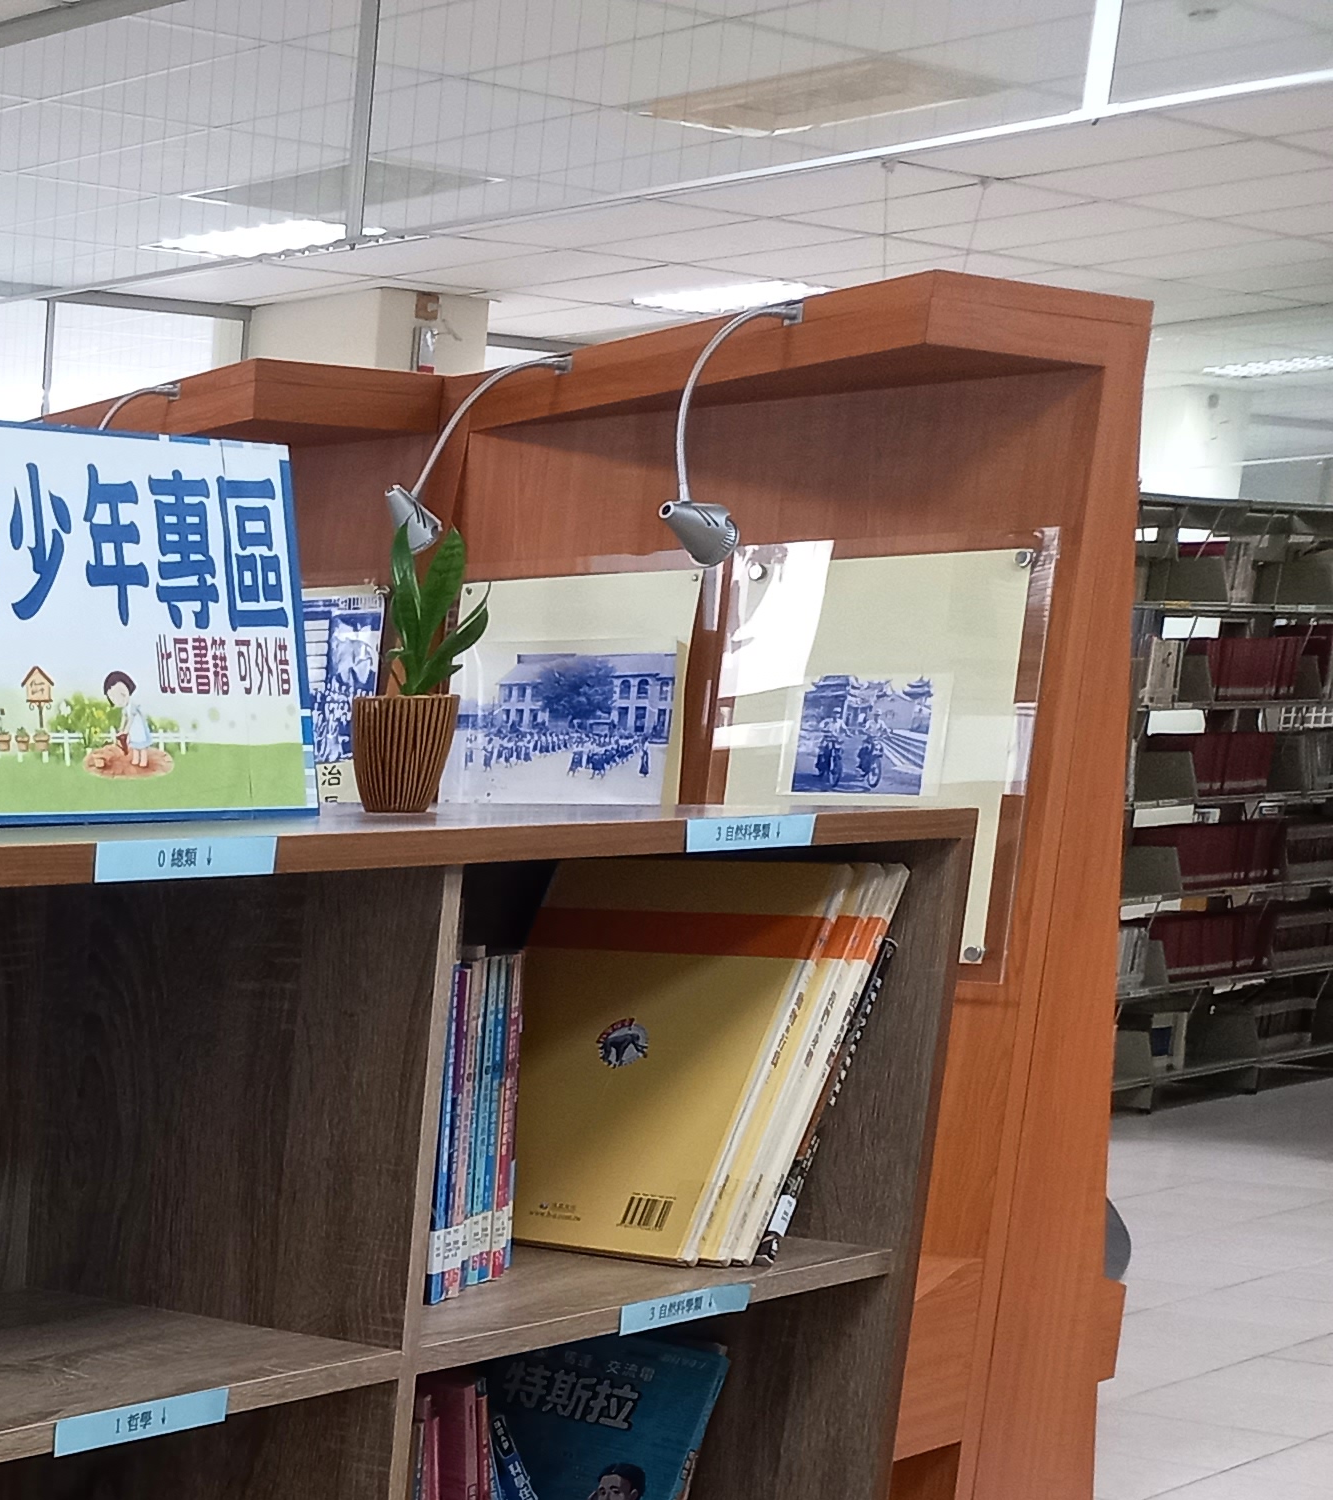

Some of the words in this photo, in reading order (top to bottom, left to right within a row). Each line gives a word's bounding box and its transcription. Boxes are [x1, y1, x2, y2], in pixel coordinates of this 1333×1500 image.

[156, 634, 230, 696] 此區書籍
[234, 638, 290, 697] 可外借
[715, 823, 723, 842] 3
[724, 821, 771, 842] 自然科學類
[157, 850, 165, 868] 0
[171, 846, 198, 869] 總類
[648, 1307, 655, 1321] 3
[658, 1296, 703, 1319] 自然科學類
[503, 1361, 641, 1431] 特斯拉
